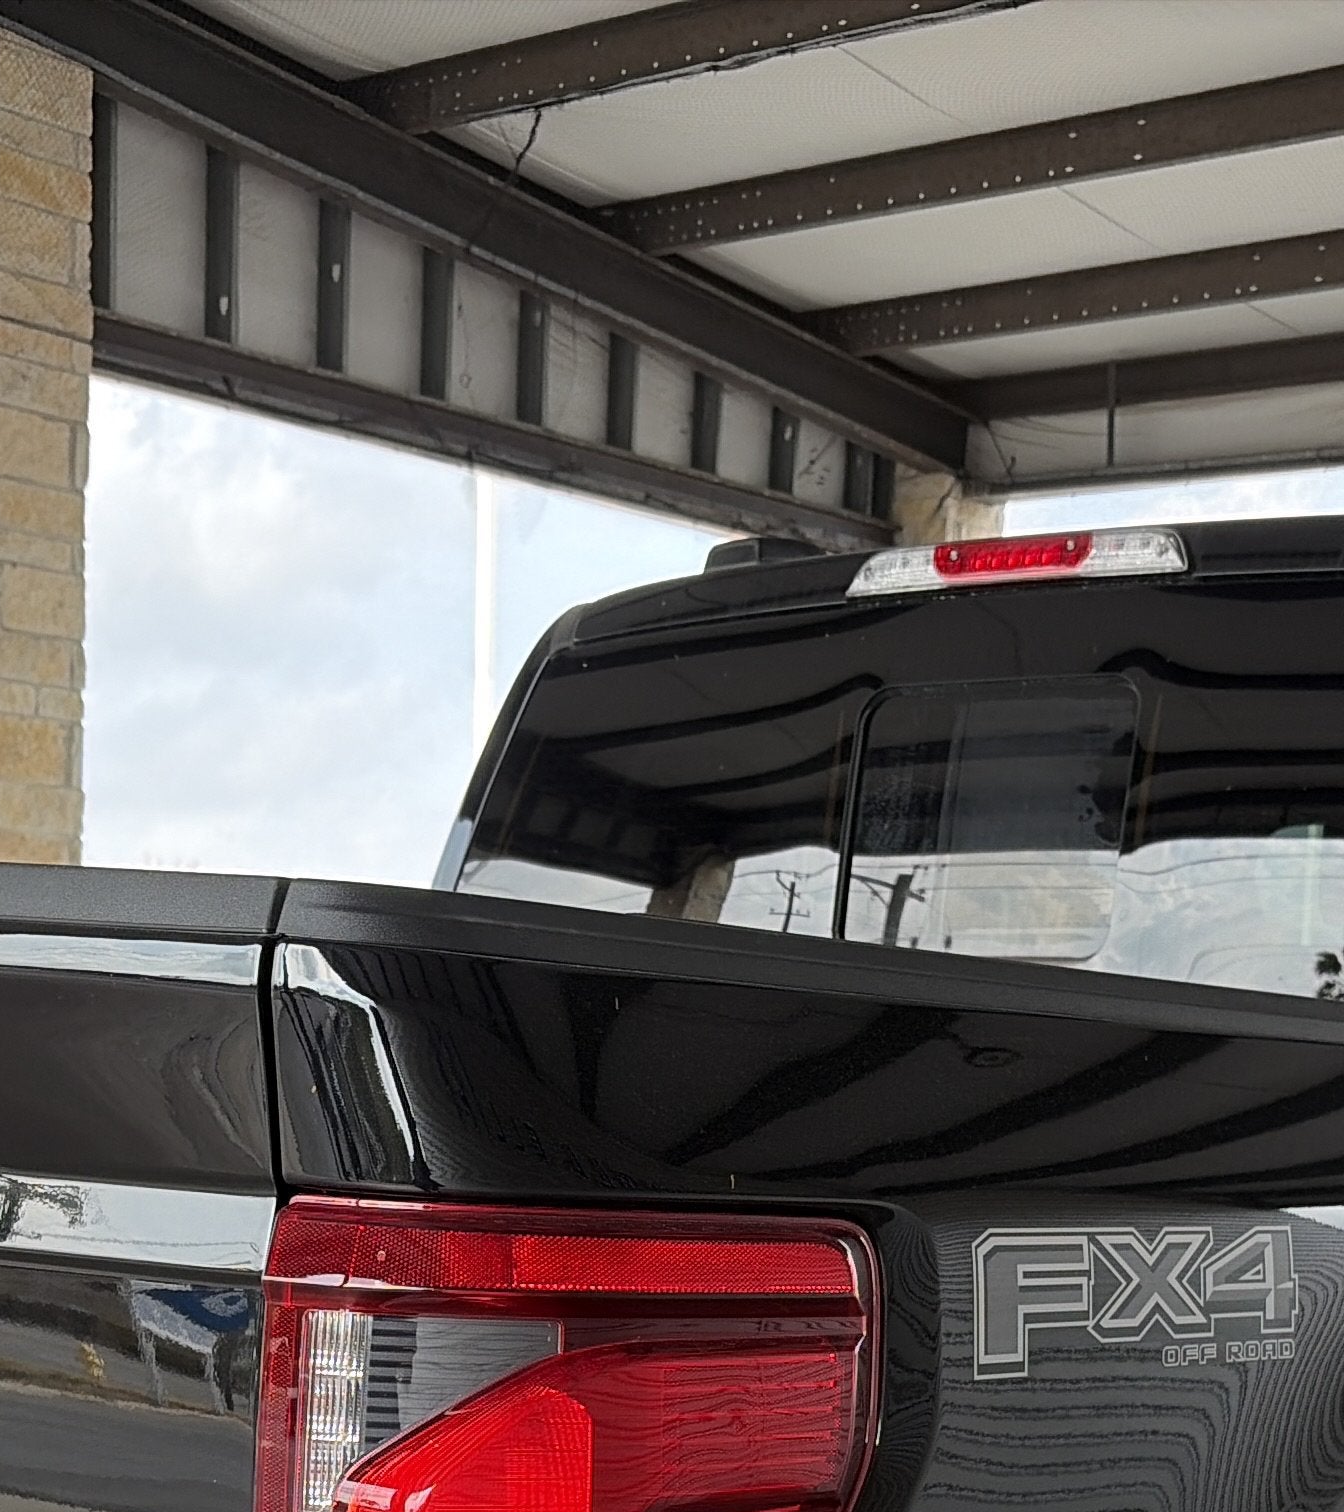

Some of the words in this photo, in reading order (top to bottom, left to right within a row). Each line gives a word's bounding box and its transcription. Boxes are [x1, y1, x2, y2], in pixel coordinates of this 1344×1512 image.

[972, 1224, 1298, 1380] FX4
[1162, 1342, 1217, 1367] OFF
[1225, 1338, 1296, 1362] ROAD
